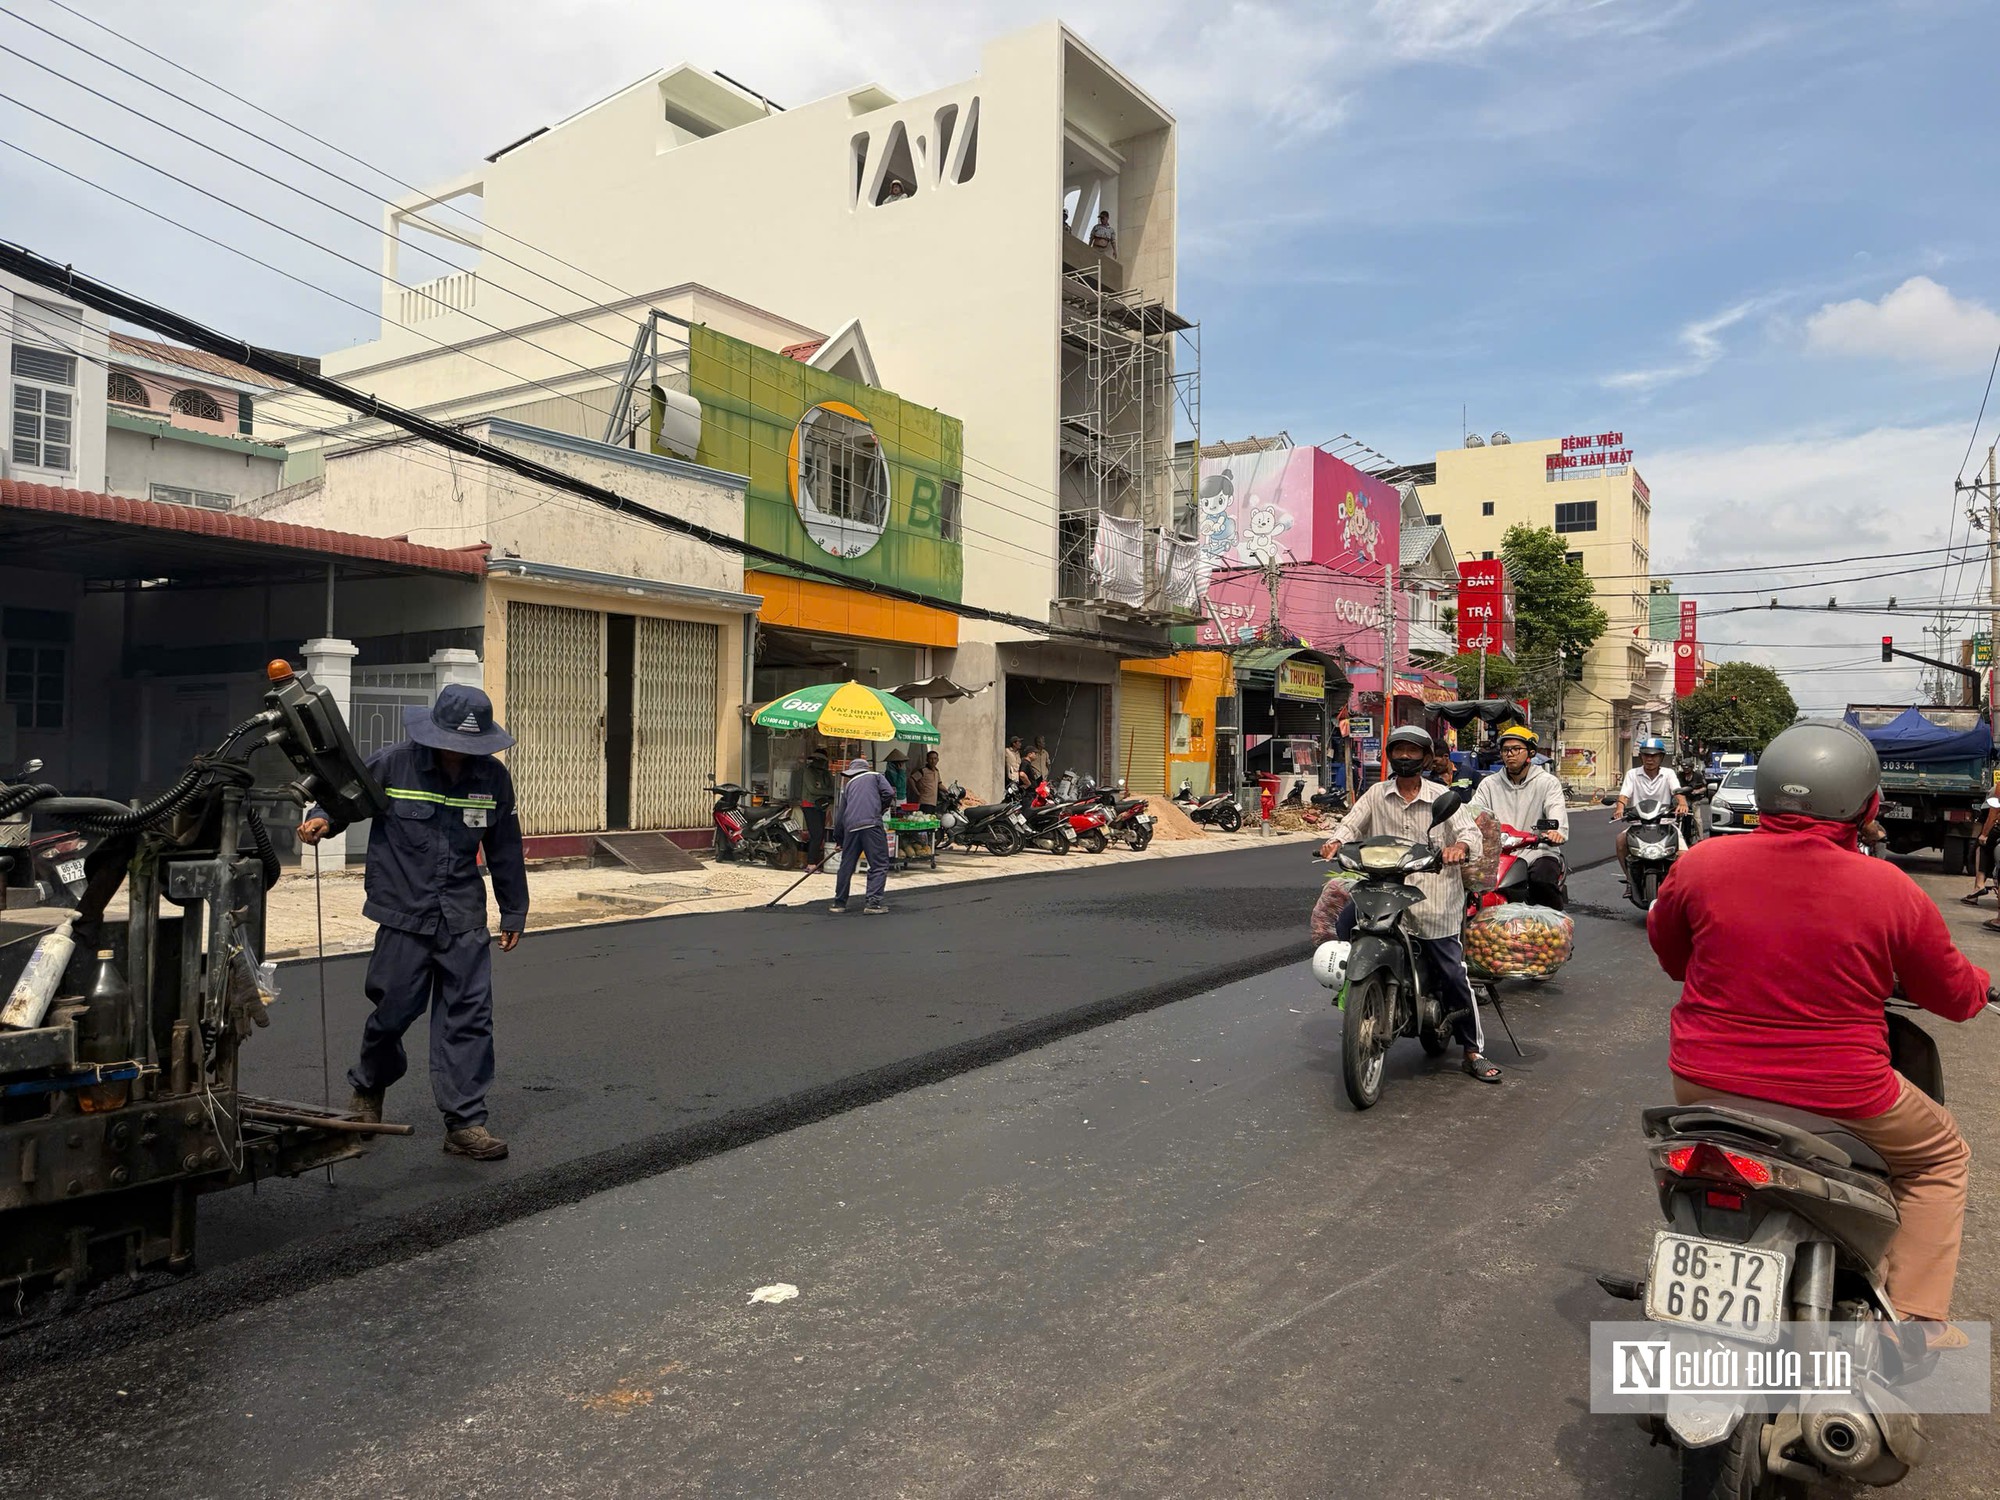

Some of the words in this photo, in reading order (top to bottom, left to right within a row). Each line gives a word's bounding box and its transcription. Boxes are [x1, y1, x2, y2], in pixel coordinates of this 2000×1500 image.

[1561, 435, 1591, 452] BỆNH
[1596, 431, 1623, 448] VIỆN
[1546, 454, 1577, 470] RĂNG
[1580, 450, 1605, 467] HÀM
[1609, 448, 1633, 465] MẶT
[1467, 572, 1495, 587] BÁN
[1466, 601, 1493, 618] TRẢ
[1467, 633, 1493, 648] GÓP
[782, 698, 823, 713] F88
[850, 708, 883, 717] NHANH
[890, 710, 924, 726] F88
[1882, 761, 1915, 770] 303-44
[1672, 1242, 1764, 1292] 86-T2
[1667, 1280, 1760, 1331] 6620
